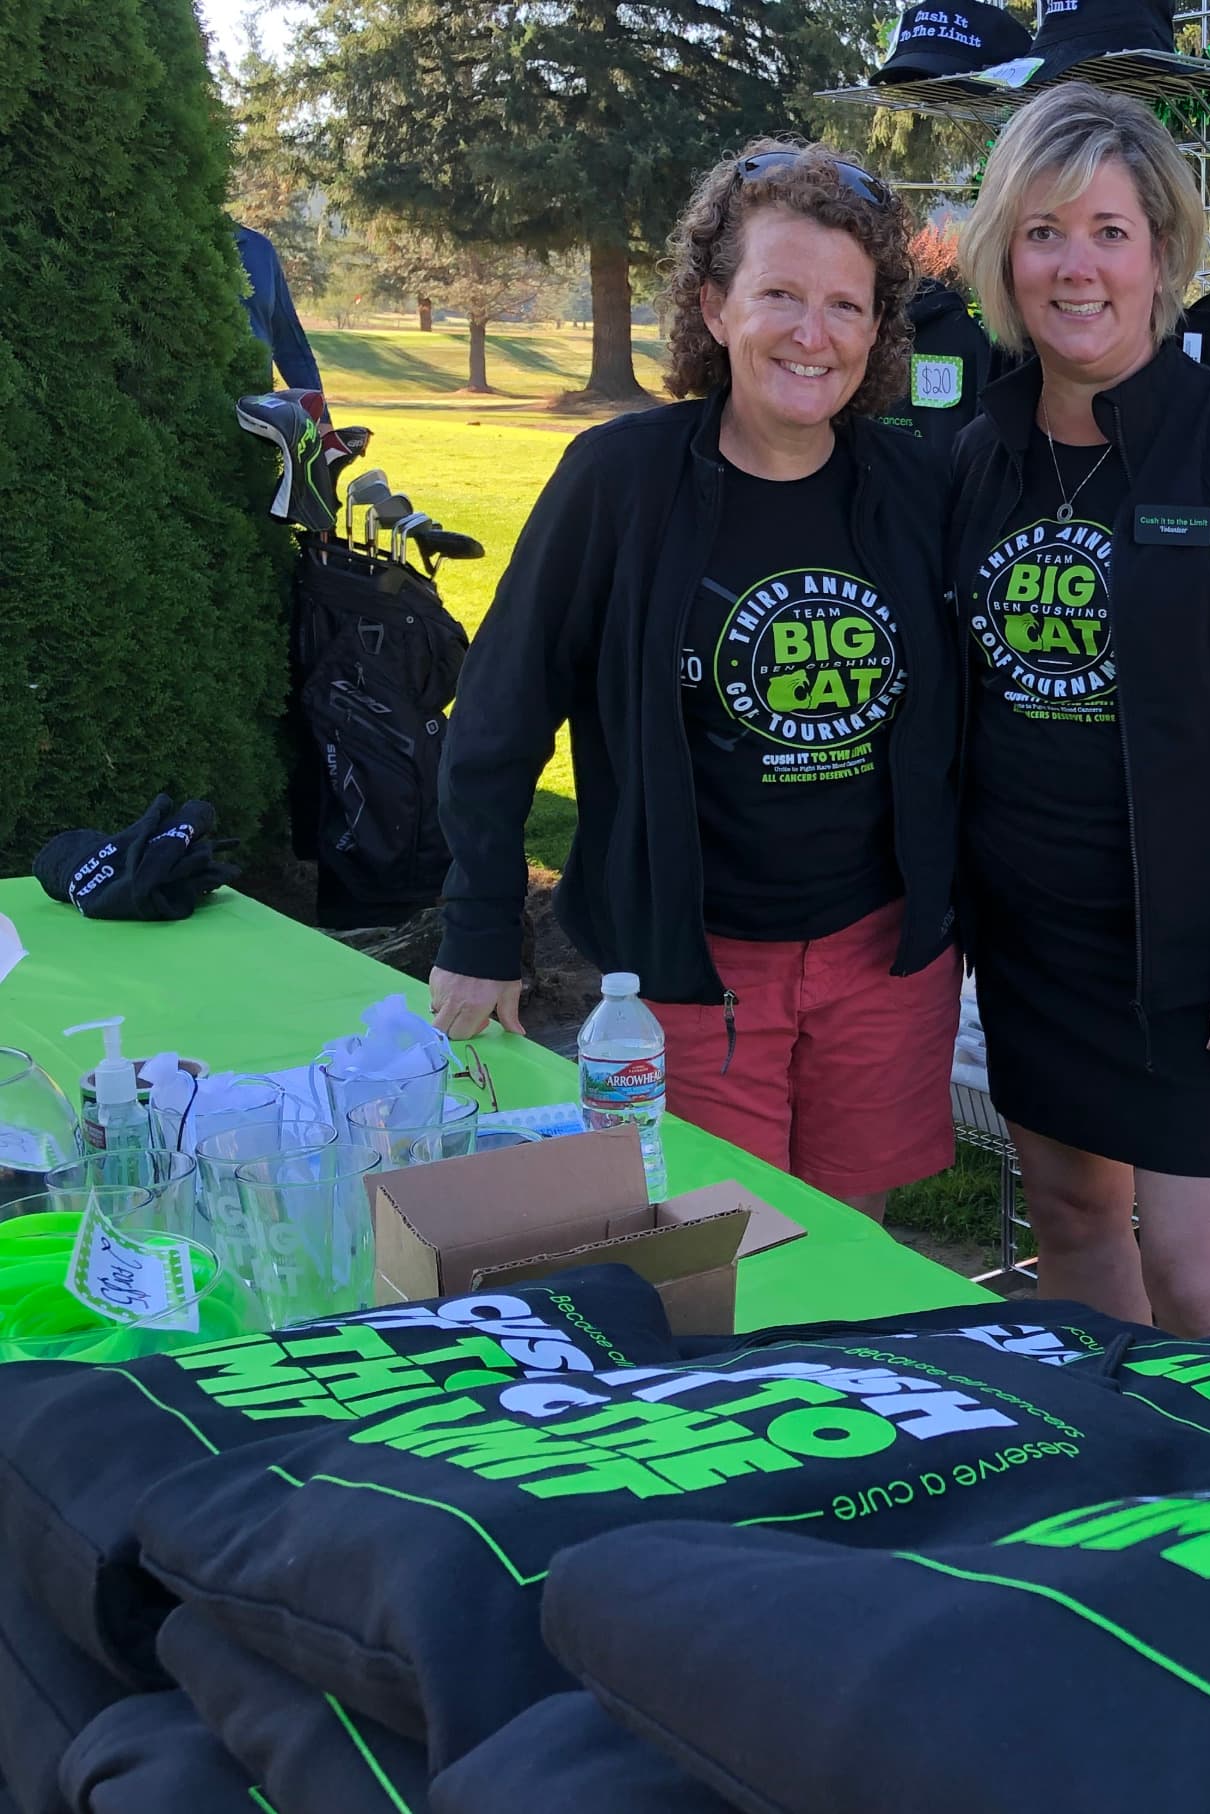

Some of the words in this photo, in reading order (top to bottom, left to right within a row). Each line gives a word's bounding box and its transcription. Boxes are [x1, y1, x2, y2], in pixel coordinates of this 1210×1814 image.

[915, 10, 948, 24] Cush
[954, 13, 969, 28] It
[911, 24, 935, 38] The
[937, 26, 982, 48] Limit
[922, 366, 951, 394] $20
[978, 526, 1045, 579] THIRD
[1055, 527, 1113, 567] ANNU
[1036, 554, 1073, 564] TEAM
[1005, 563, 1096, 607] BIG
[728, 581, 789, 644] THIRD
[793, 607, 841, 619] TEAM
[993, 601, 1021, 612] BEN
[1030, 604, 1108, 618] CUSHING
[772, 616, 876, 664] BIG
[1004, 613, 1101, 656] CAT
[760, 664, 795, 675] BEN
[805, 656, 891, 670] CUSHING
[971, 615, 1013, 668] GOLF
[1011, 653, 1117, 697] TOURNAM
[767, 668, 882, 712] CAT
[327, 744, 336, 776] SUN
[762, 754, 795, 765] CUSH
[797, 753, 809, 764] IT
[811, 752, 828, 763] TO
[761, 774, 777, 783] ALL
[780, 773, 817, 782] CANCERS
[99, 843, 118, 858] To
[75, 858, 100, 881] The
[77, 865, 115, 896] Cush
[607, 1070, 662, 1087] ARROWHEAD
[438, 1294, 593, 1378] CUS
[548, 1294, 613, 1349] Because
[608, 1350, 637, 1368] all
[150, 1333, 360, 1420] IMIT
[842, 1347, 947, 1376] Because
[703, 1378, 897, 1458] TO
[348, 1396, 685, 1499] LIMIT
[540, 1400, 804, 1492] THE
[952, 1441, 1080, 1487] deserve
[832, 1480, 914, 1520] cure
[920, 1474, 946, 1496] a
